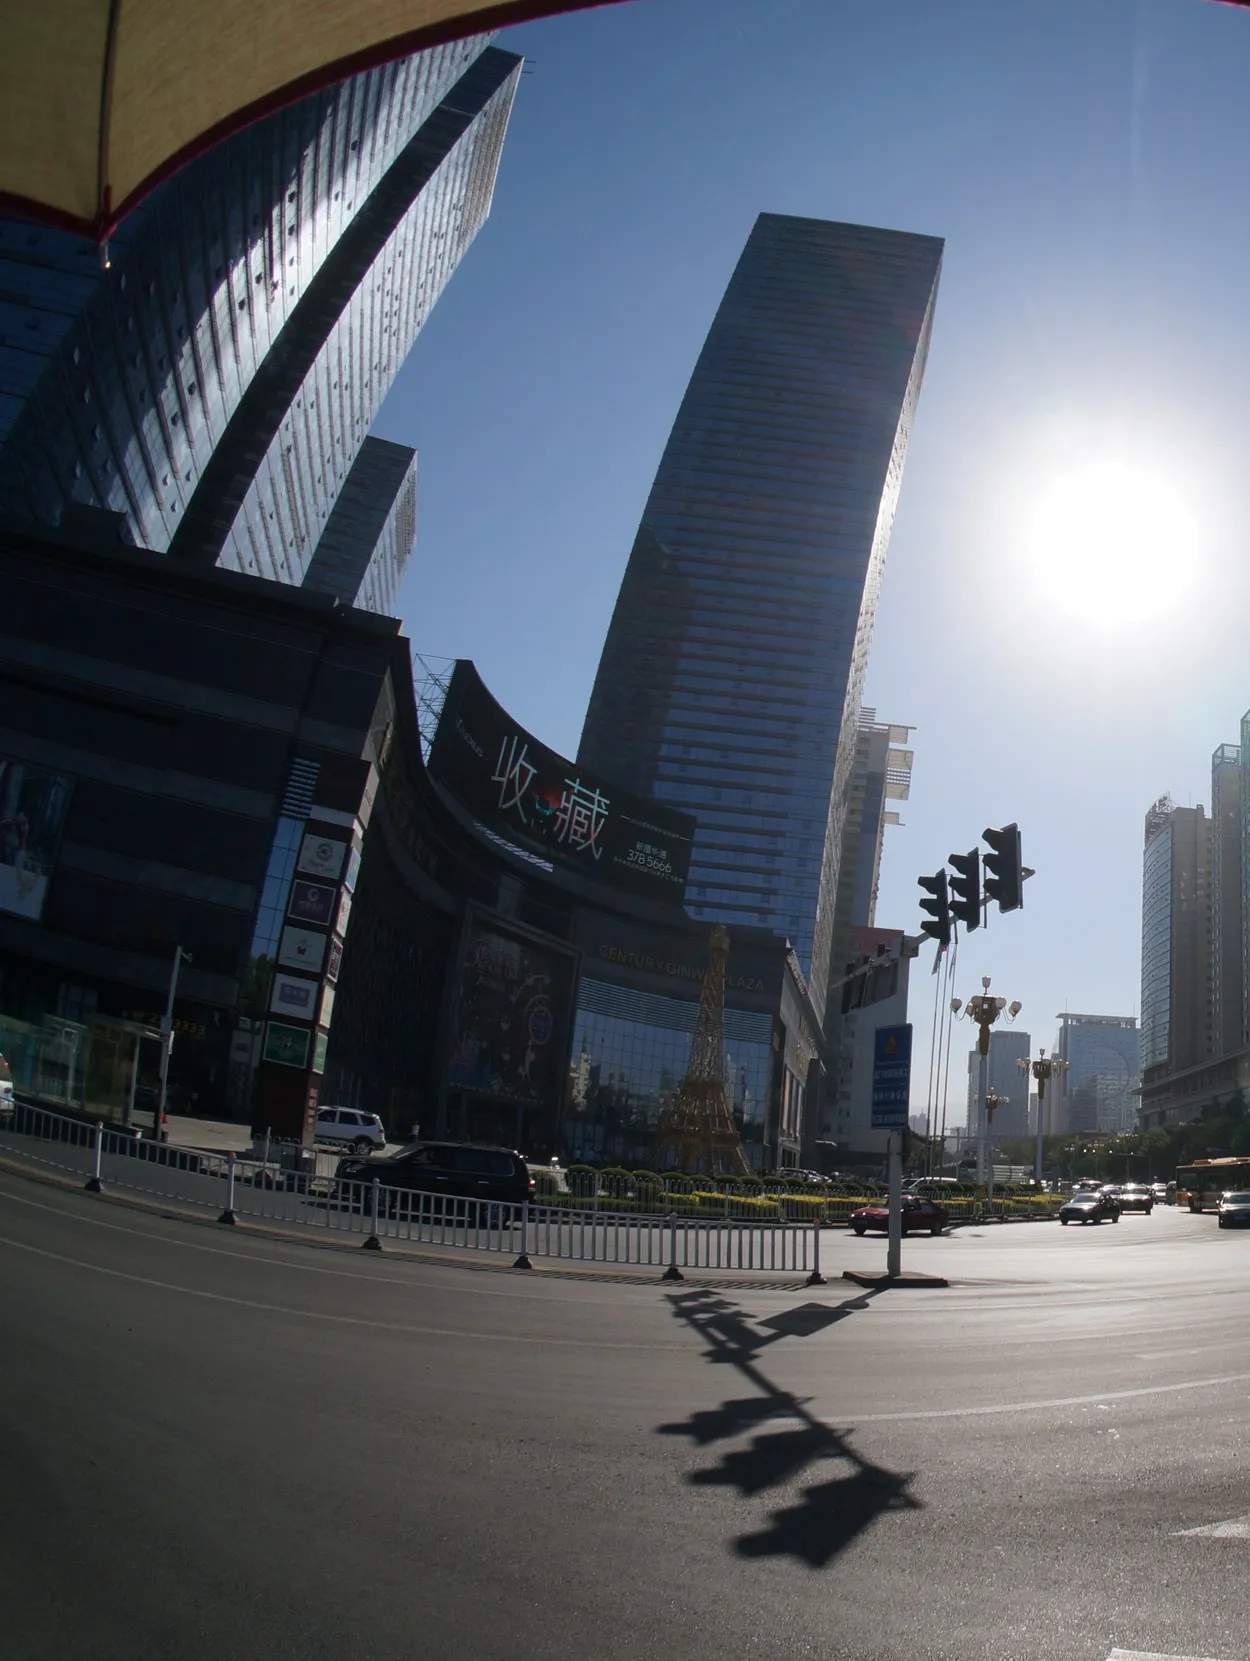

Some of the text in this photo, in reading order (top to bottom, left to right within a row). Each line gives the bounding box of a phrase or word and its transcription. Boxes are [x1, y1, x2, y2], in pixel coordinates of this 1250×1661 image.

[626, 849, 646, 865] 378
[645, 855, 672, 873] 5666
[598, 944, 764, 991] CENTURY GINW LAZA
